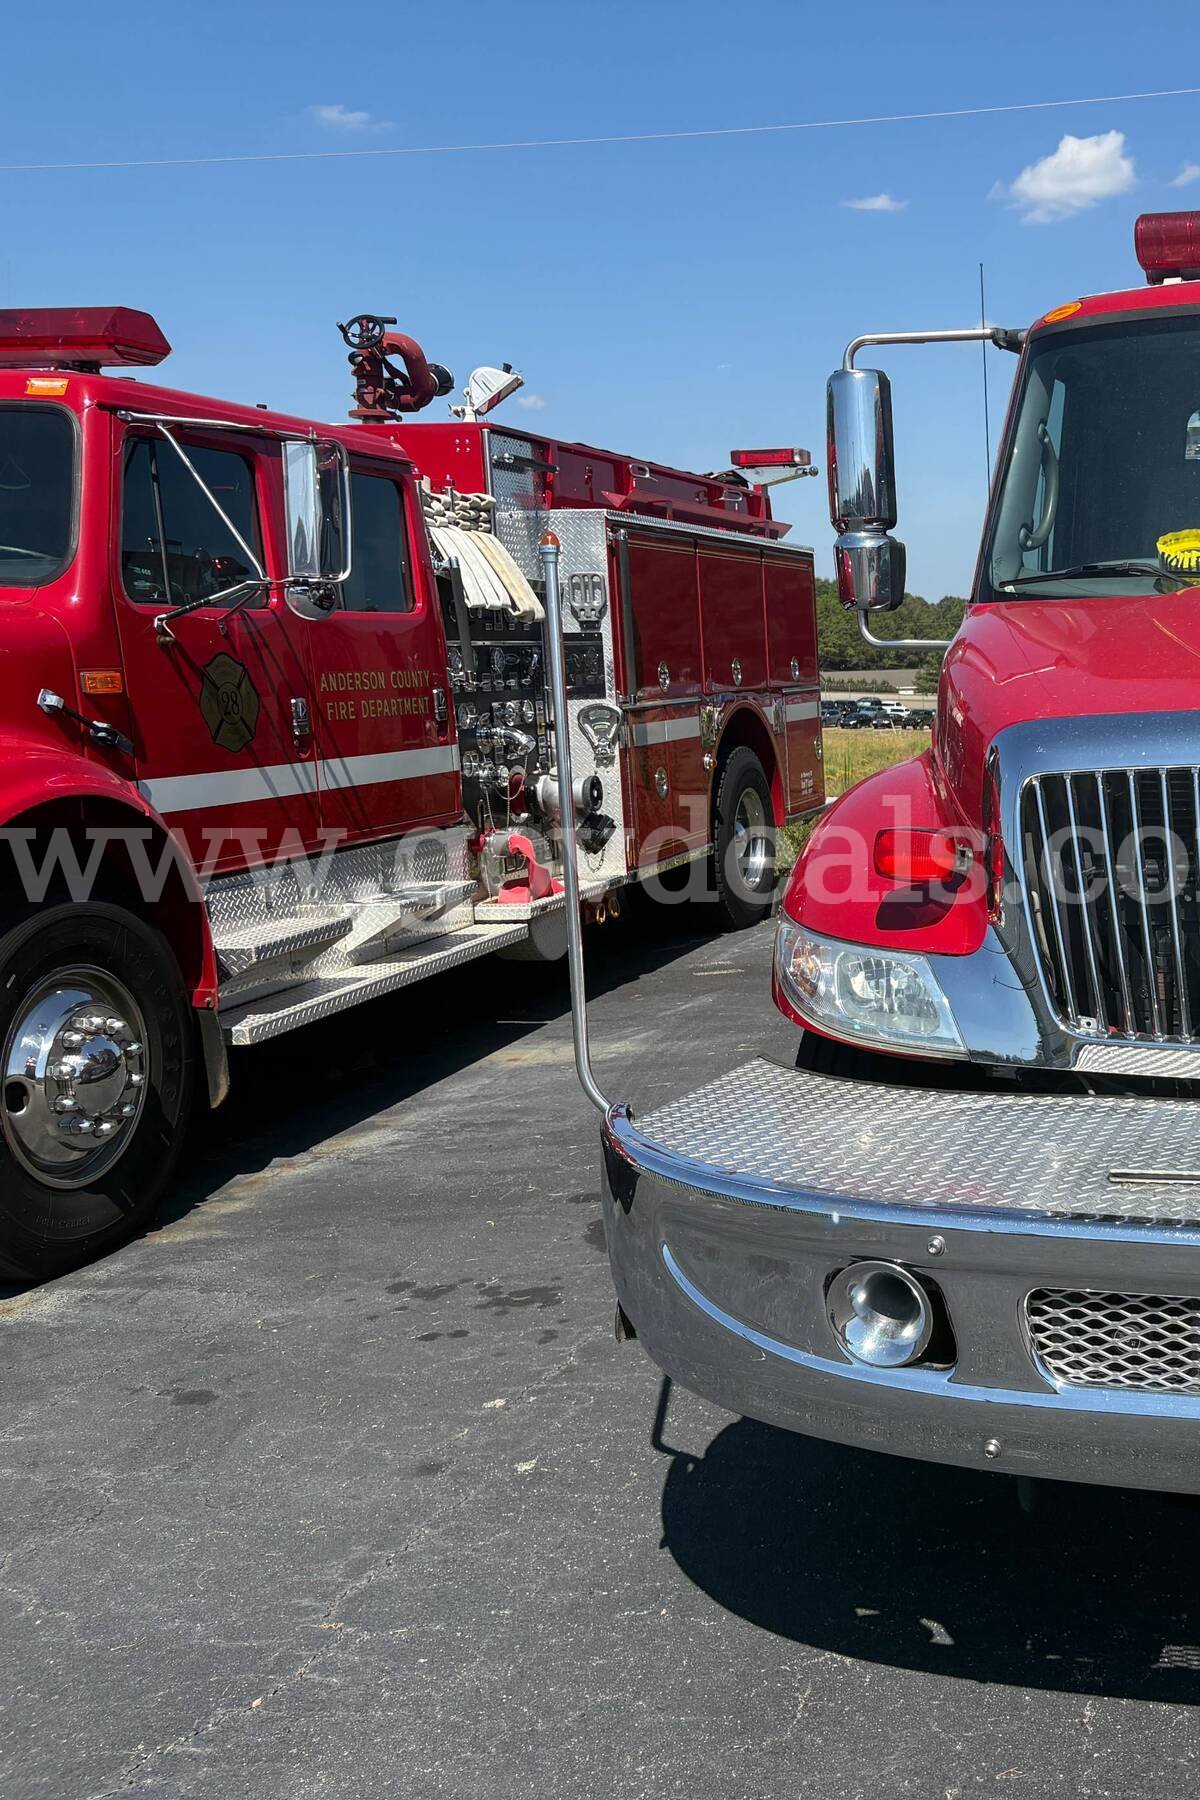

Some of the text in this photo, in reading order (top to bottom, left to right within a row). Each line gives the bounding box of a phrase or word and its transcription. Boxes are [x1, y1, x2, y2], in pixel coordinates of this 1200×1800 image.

[320, 670, 430, 692] ANDERSON COUNTY
[221, 690, 240, 716] 28
[326, 697, 430, 721] FIRE DEPARTMENT
